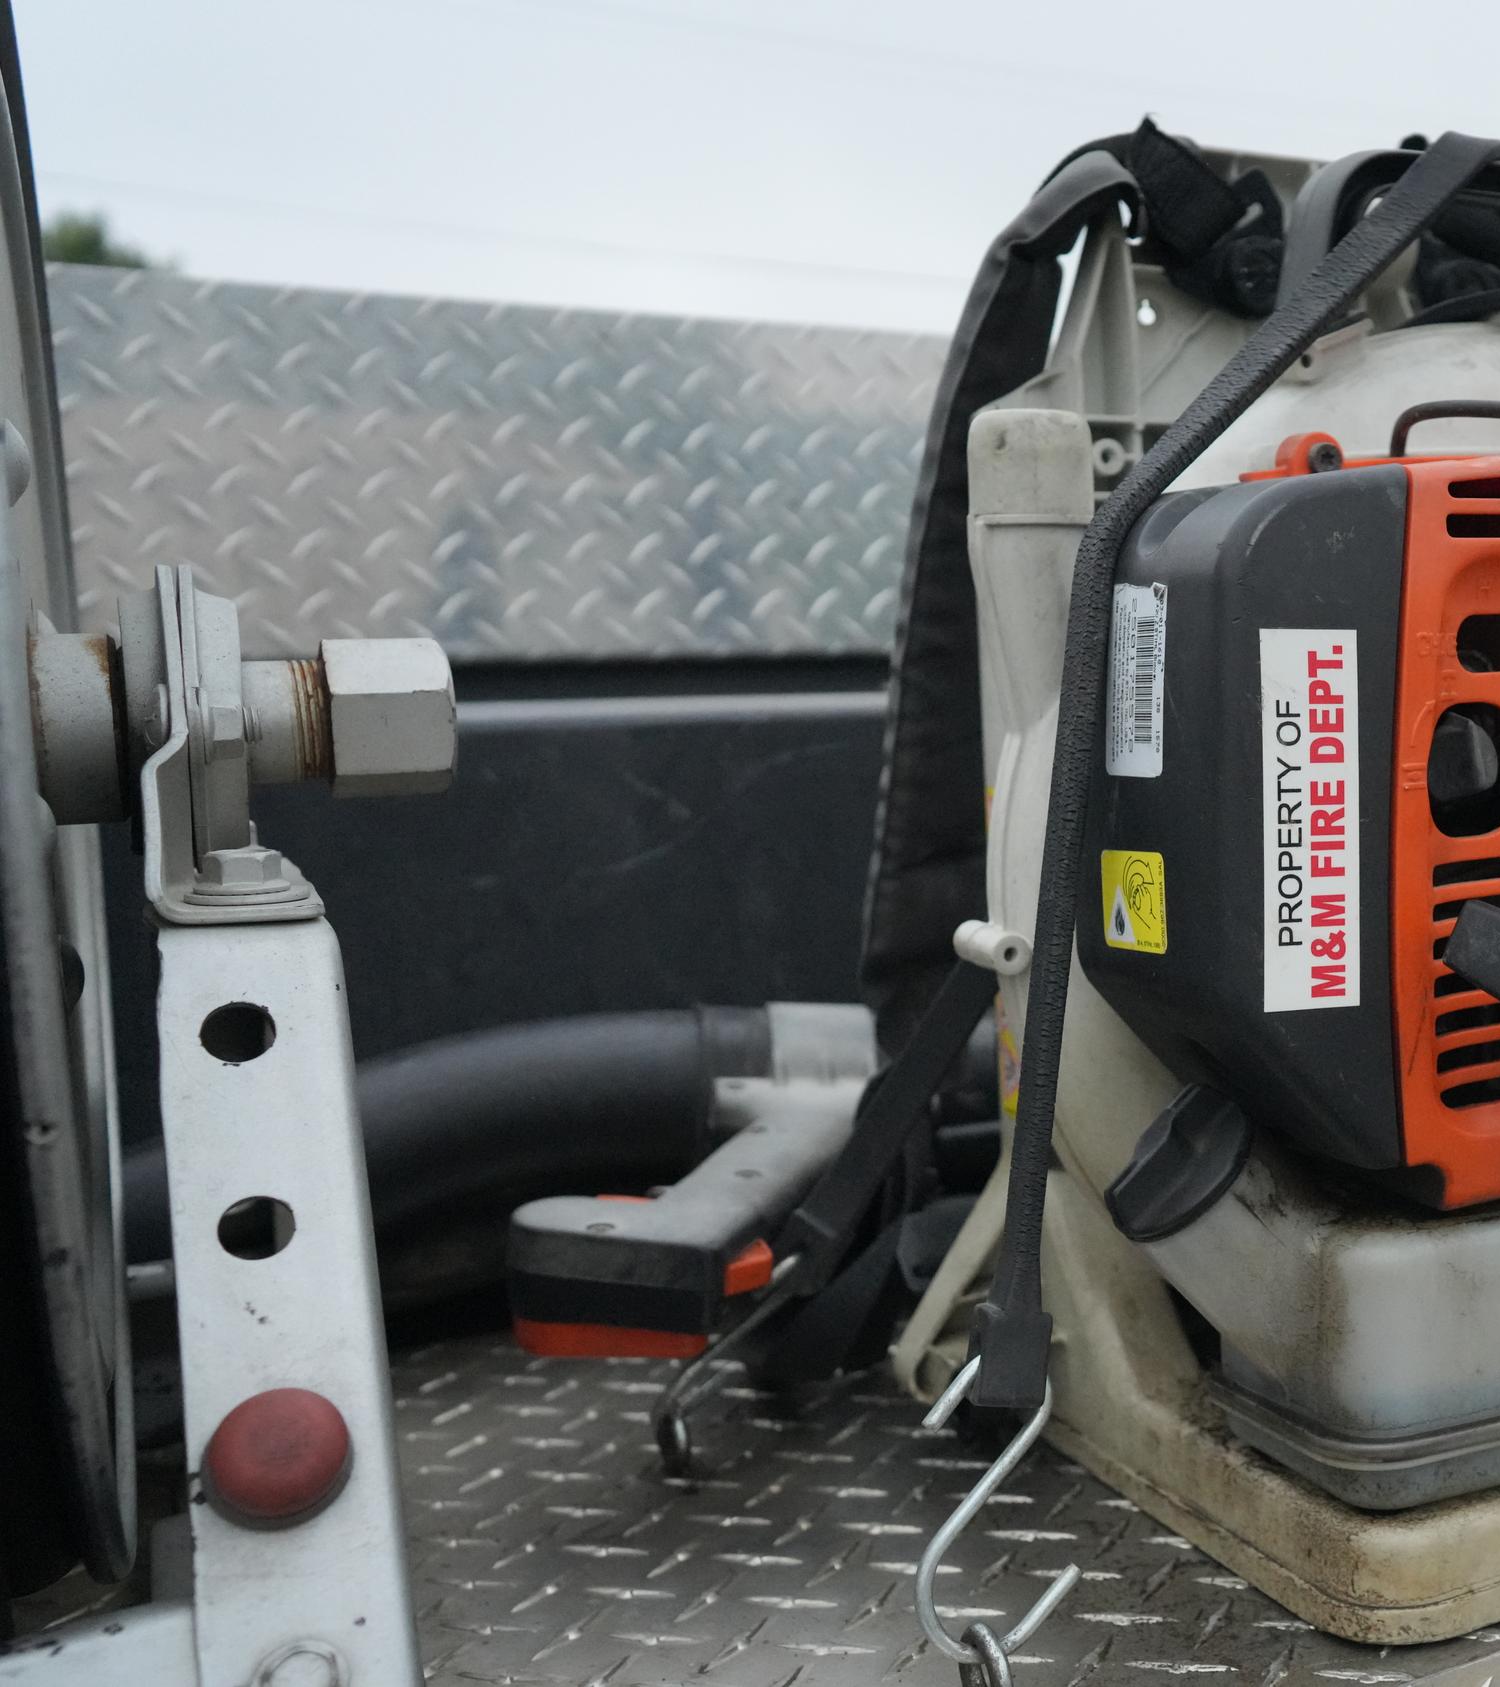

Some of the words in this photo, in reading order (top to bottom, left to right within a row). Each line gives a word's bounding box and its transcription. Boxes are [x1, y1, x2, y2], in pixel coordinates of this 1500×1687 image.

[1276, 699, 1302, 747] OF
[1307, 644, 1345, 764] DEPT.
[1277, 756, 1303, 948] PROPERTY
[1310, 779, 1346, 879] FIRE
[1310, 893, 1347, 999] M&M
